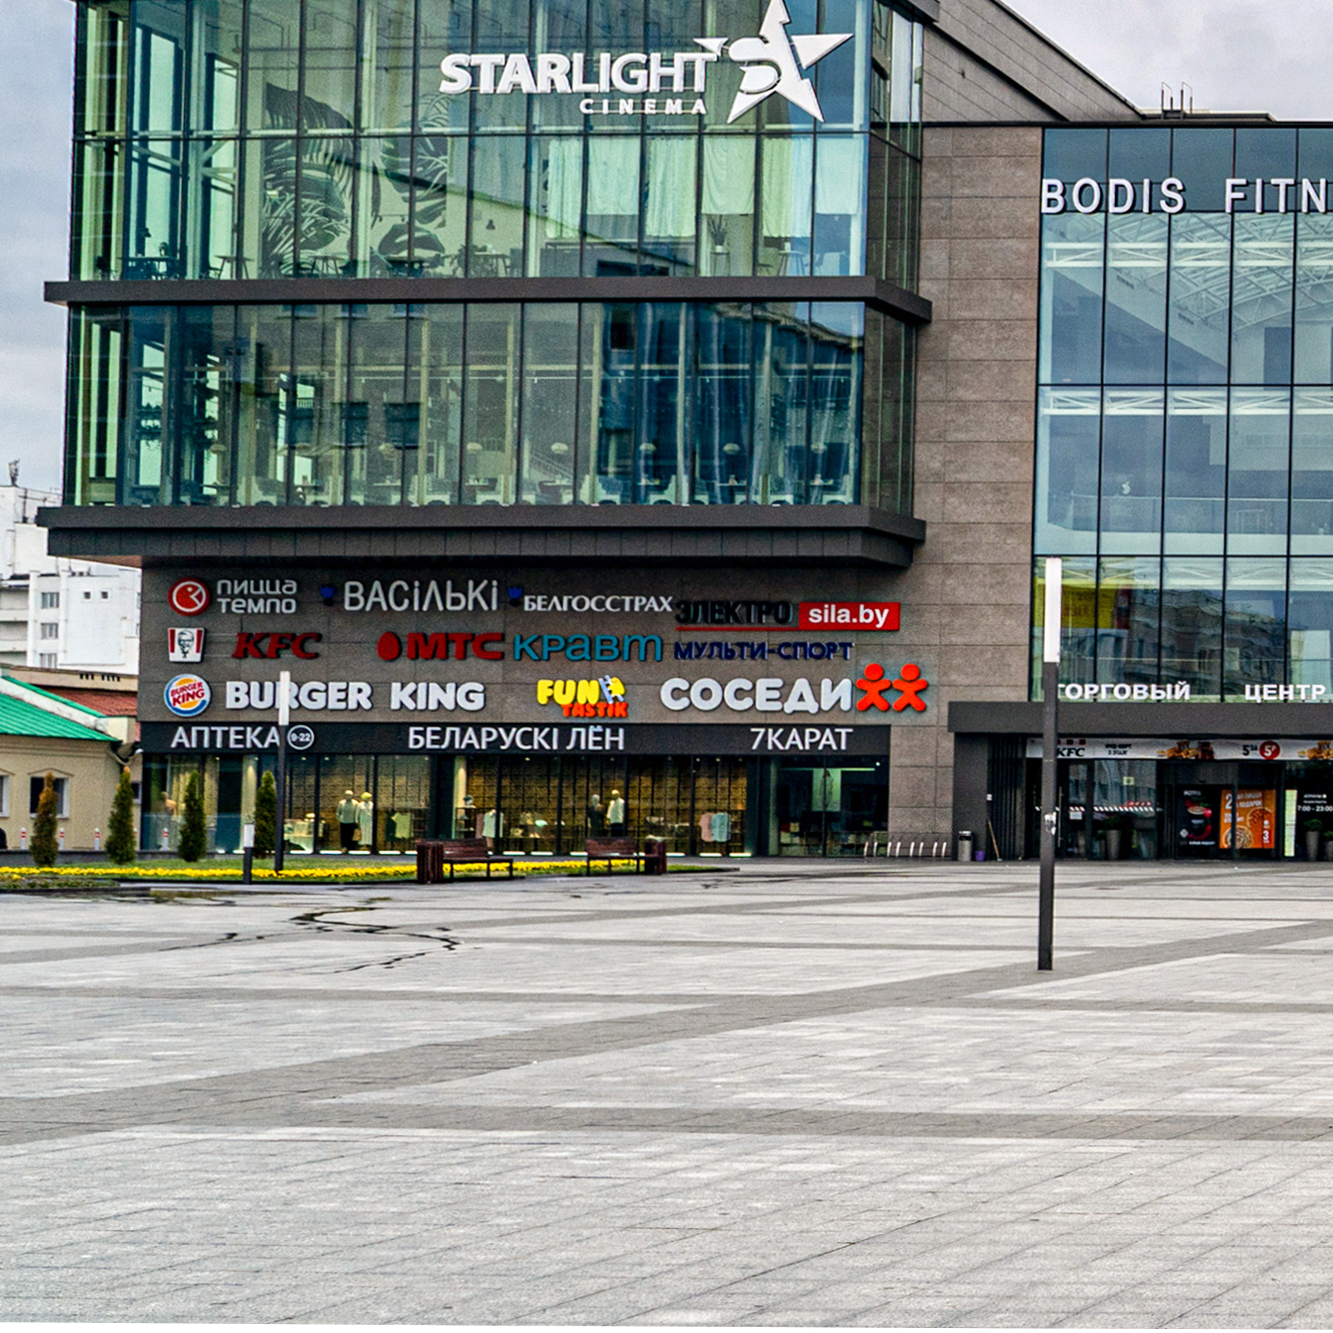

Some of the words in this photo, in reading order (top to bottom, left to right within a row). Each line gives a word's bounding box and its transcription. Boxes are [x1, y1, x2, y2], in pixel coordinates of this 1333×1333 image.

[439, 51, 718, 95] STARLIGHT
[579, 97, 707, 115] CINEMA
[1040, 177, 1186, 214] BODIS
[523, 594, 674, 613] БЕЛГОССТРАХ
[674, 600, 794, 625] ЭЛЕКТРО
[808, 604, 890, 628] sila.by
[231, 631, 323, 660] KFC
[406, 632, 505, 661] МТС
[673, 640, 856, 661] МУЛЬТИ-СПОРТ
[170, 681, 203, 697] BURGER
[172, 688, 205, 707] KING
[225, 680, 373, 710] BURGER
[390, 680, 487, 711] KING
[536, 679, 600, 705] FUN
[659, 677, 853, 715] СОСЕДИ
[1244, 683, 1327, 703] ЦЕНТР
[561, 701, 629, 717] TASTIK
[170, 725, 281, 749] АПТЕКА
[290, 732, 311, 742] 9-22
[408, 726, 559, 750] БЕЛАРУСКІ
[565, 724, 625, 750] ЛЁН
[750, 727, 854, 750] 7КАРАТ
[1057, 747, 1086, 757] KFC
